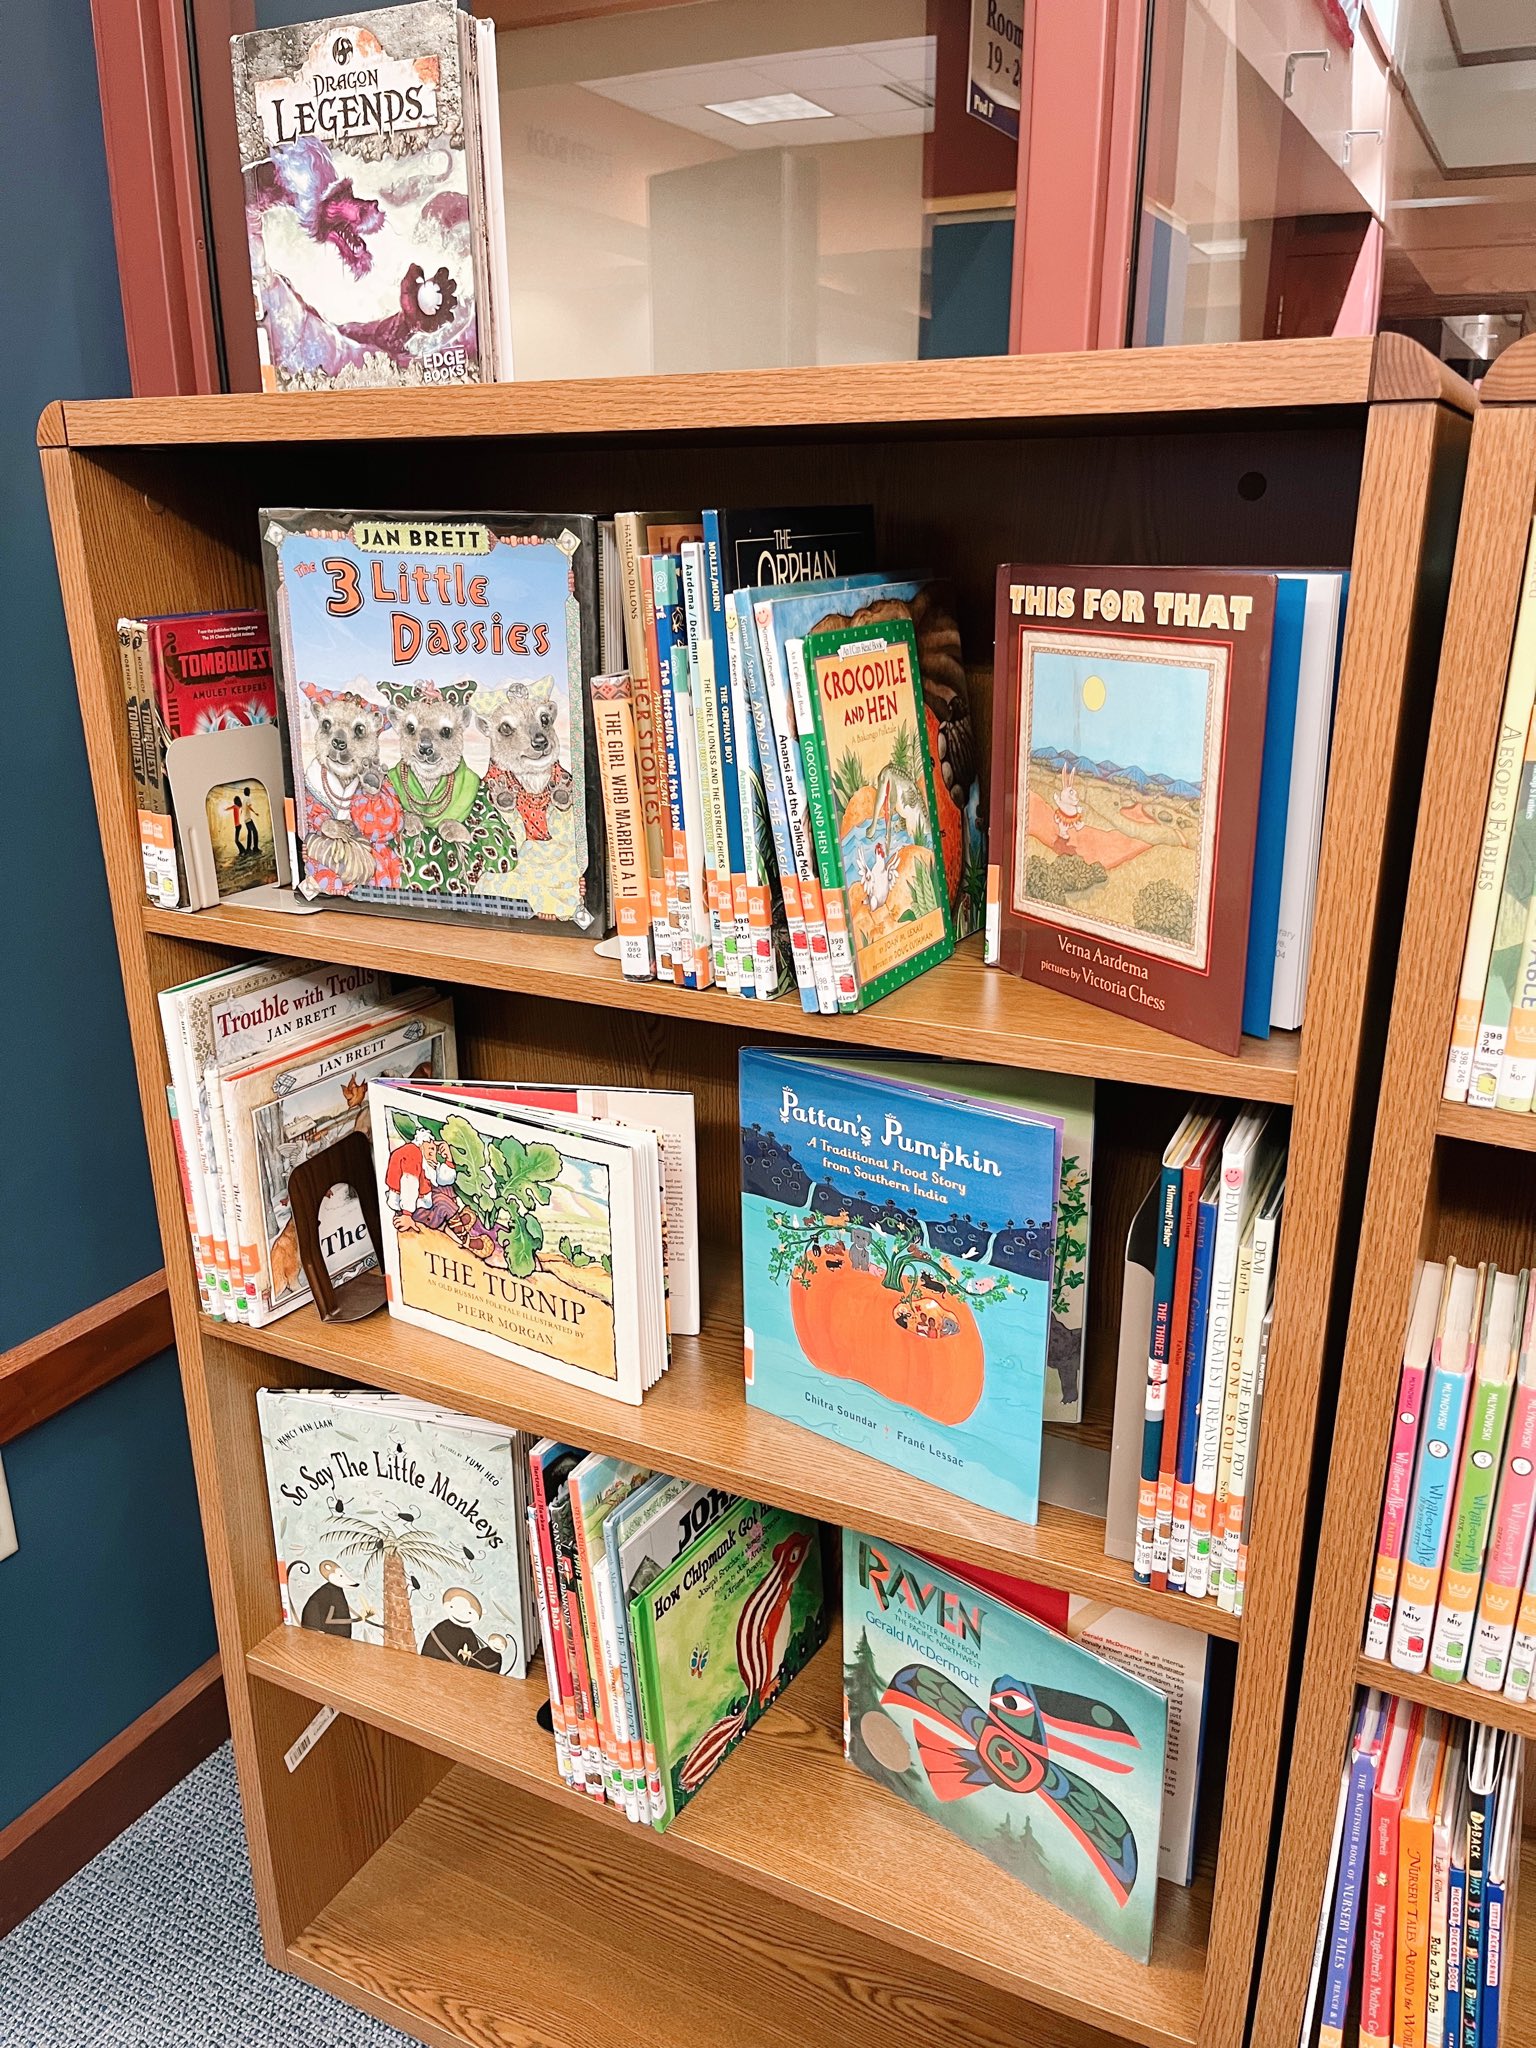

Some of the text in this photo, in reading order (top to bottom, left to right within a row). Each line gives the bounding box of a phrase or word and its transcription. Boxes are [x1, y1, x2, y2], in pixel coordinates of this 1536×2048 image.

[987, 42, 1003, 73] 19
[312, 69, 378, 98] DRAGON
[271, 85, 425, 146] LEGENDS
[423, 350, 466, 369] EDGE
[423, 364, 466, 383] BOOKS
[361, 528, 481, 549] JAN BRETT
[773, 529, 792, 551] THE
[293, 556, 490, 618] The 3 Little
[624, 524, 638, 620] HAMILTON DILLONS
[757, 549, 837, 588] ORPHAN
[1009, 584, 1253, 632] THIS FOR THAT
[390, 610, 551, 666] Dassies
[178, 646, 272, 679] TOMBQUEST
[822, 657, 907, 702] CROCODILE
[193, 687, 228, 700] AMULET
[844, 690, 898, 727] AND HEN
[126, 705, 145, 782] TOMBQUEST
[140, 708, 158, 786] TOMBQUEST
[604, 711, 622, 736] THE
[719, 685, 733, 765] THE ORPHAN BOY
[608, 740, 625, 770] GIRL
[638, 729, 661, 826] STORIES
[612, 774, 629, 805] WHO
[779, 734, 805, 858] Anansi and the Talking
[804, 740, 829, 855] CROCODILE AND HEN
[1478, 724, 1523, 892] AESOP'S FABLES
[615, 809, 635, 866] MARRIED
[621, 872, 631, 880] A
[1058, 934, 1148, 980] Verna Aardema
[216, 963, 376, 1040] Trouble with Trolls
[1041, 960, 1166, 1011] pictures by Victoria Chess
[266, 1004, 338, 1043] JAN BRETT
[1483, 1032, 1503, 1041] 398
[318, 1039, 386, 1078] JAN BRETT
[1481, 1047, 1504, 1056] McG
[778, 1085, 1003, 1178] Pattan's Pumpkin
[806, 1137, 967, 1197] A Traditional Flood Story
[822, 1156, 949, 1205] from Southern India
[321, 1221, 367, 1258] The
[1163, 1184, 1177, 1248] Kimmel/Fisher
[1239, 1259, 1251, 1294] Muth
[1253, 1240, 1267, 1275] DEMI
[424, 1251, 586, 1326] THE TURNIP
[427, 1279, 585, 1340] AN OLD RUSSIAN FOLKTALE ILLUSTRATED BY
[456, 1302, 554, 1346] PIERR MORGAN
[1151, 1303, 1168, 1400] THE THREE PRINCES
[1201, 1281, 1231, 1472] THE GREATEST TREASURE
[1221, 1336, 1244, 1465] STONE SOUP
[804, 1391, 965, 1468] Chitra Soundar Frané Lessac
[1232, 1370, 1254, 1480] THE EMPTY POT
[1436, 1382, 1453, 1431] MLYNOWSKI
[1481, 1392, 1499, 1441] MLYNOWSKI
[277, 1419, 333, 1445] NANCY VAN LAAN
[1434, 1443, 1443, 1455] 2
[464, 1455, 500, 1487] YUMI HEO
[1479, 1452, 1488, 1464] 3
[280, 1450, 504, 1549] So Say The Little Monkeys
[1424, 1484, 1445, 1543] Whatever
[1467, 1494, 1489, 1553] Whatever
[654, 1506, 759, 1621] How Chipmunk Got
[544, 1565, 561, 1631] Granite Baby
[858, 1540, 989, 1652] RAVEN
[1402, 1610, 1421, 1622] Mly
[894, 1613, 982, 1670] THE PACIFIC NORTHWEST
[904, 1609, 939, 1636] TRICKSTER
[940, 1631, 956, 1646] TALE
[957, 1640, 980, 1660] FROM
[1081, 1630, 1103, 1642] Gerald
[1105, 1637, 1143, 1655] McDermott
[1447, 1617, 1463, 1627] Mly
[1480, 1630, 1500, 1641] Mly
[865, 1610, 980, 1688] Gerald McDermott
[1470, 1811, 1485, 1859] TABACK
[1373, 1903, 1386, 1928] Mary
[1430, 1935, 1441, 1957] Rub
[1368, 1985, 1382, 2019] Mother
[1428, 1994, 1439, 2014] Dub
[1429, 1969, 1440, 1991] Dub
